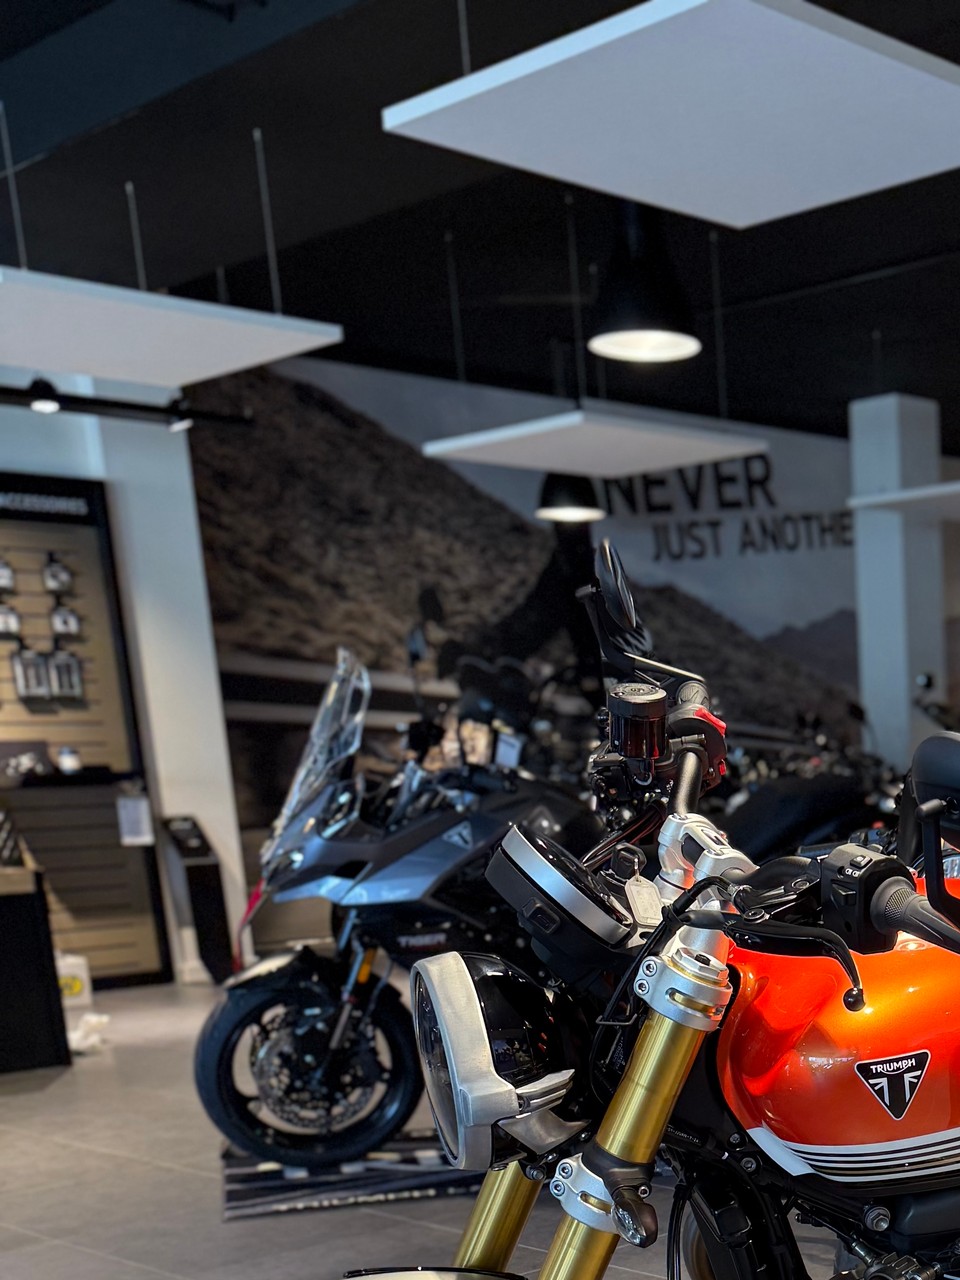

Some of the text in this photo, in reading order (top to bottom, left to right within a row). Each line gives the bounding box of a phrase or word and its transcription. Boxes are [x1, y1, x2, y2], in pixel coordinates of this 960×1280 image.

[604, 453, 776, 516] NEVER
[652, 510, 854, 563] JUST ANOTHE
[870, 1058, 916, 1074] TRIUMPH
